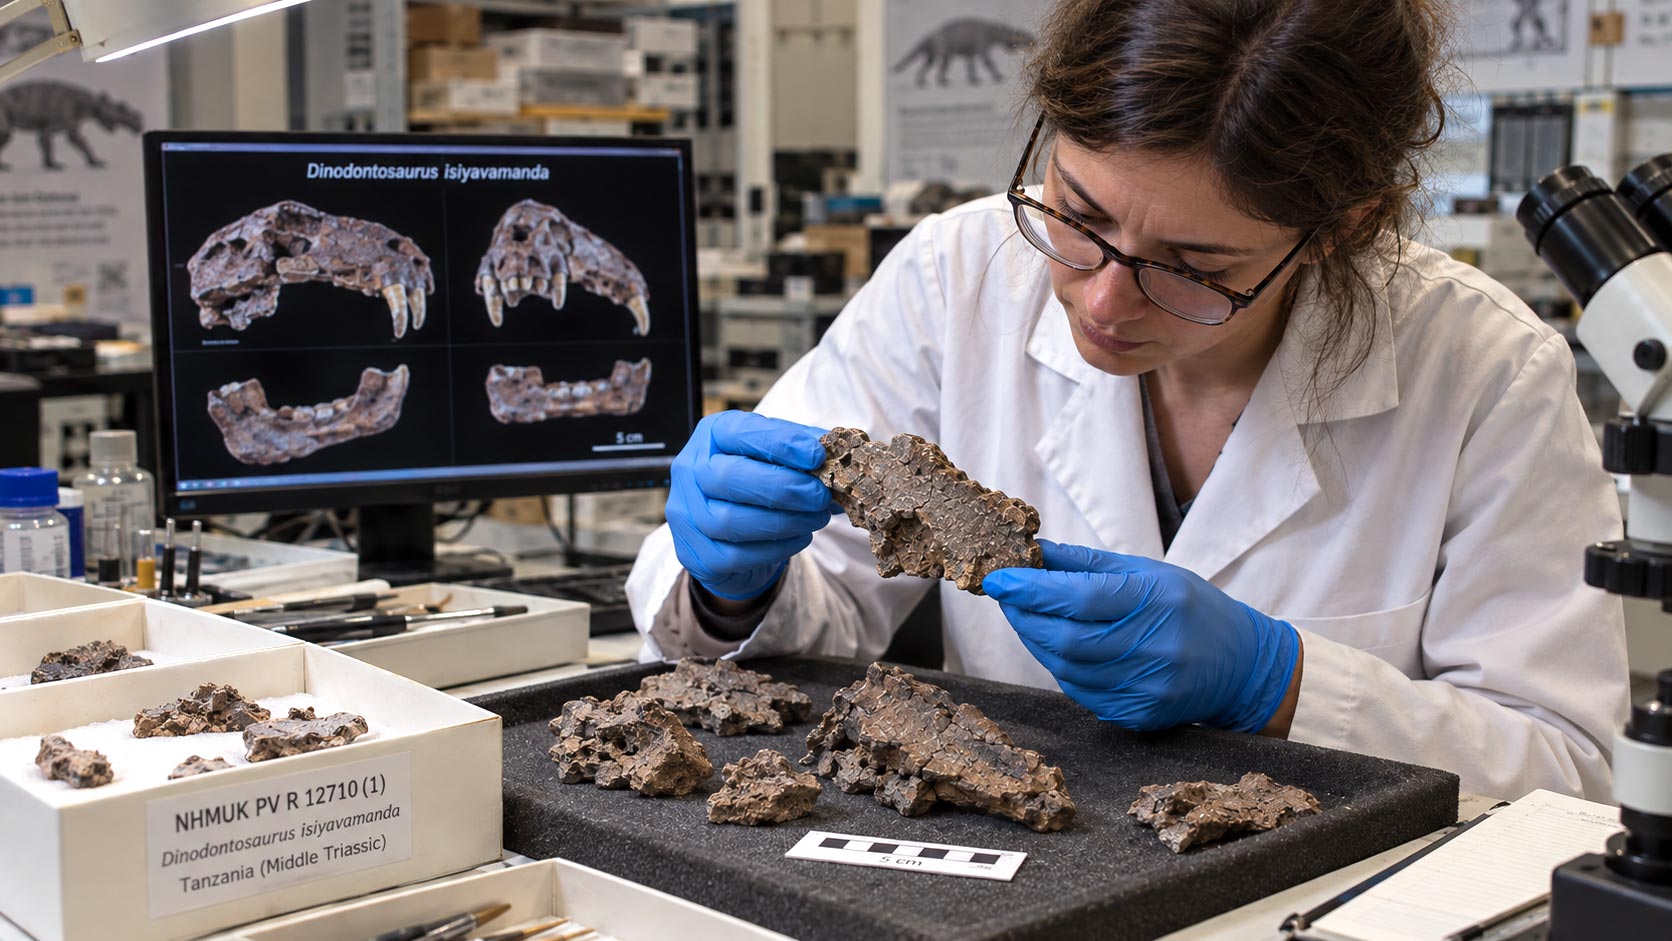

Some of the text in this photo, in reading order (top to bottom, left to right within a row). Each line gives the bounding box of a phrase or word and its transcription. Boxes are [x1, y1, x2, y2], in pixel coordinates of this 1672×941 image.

[307, 162, 550, 183] Dinodontosaurus isiyavamanda
[616, 431, 644, 444] 5 cm
[175, 773, 386, 833] NHMUK PV R 12710 (1)
[161, 804, 400, 868] Dinodontosaurus isiyavamanda
[179, 834, 387, 893] Tanzania (Middle Triassic)
[896, 858, 922, 867] cm
